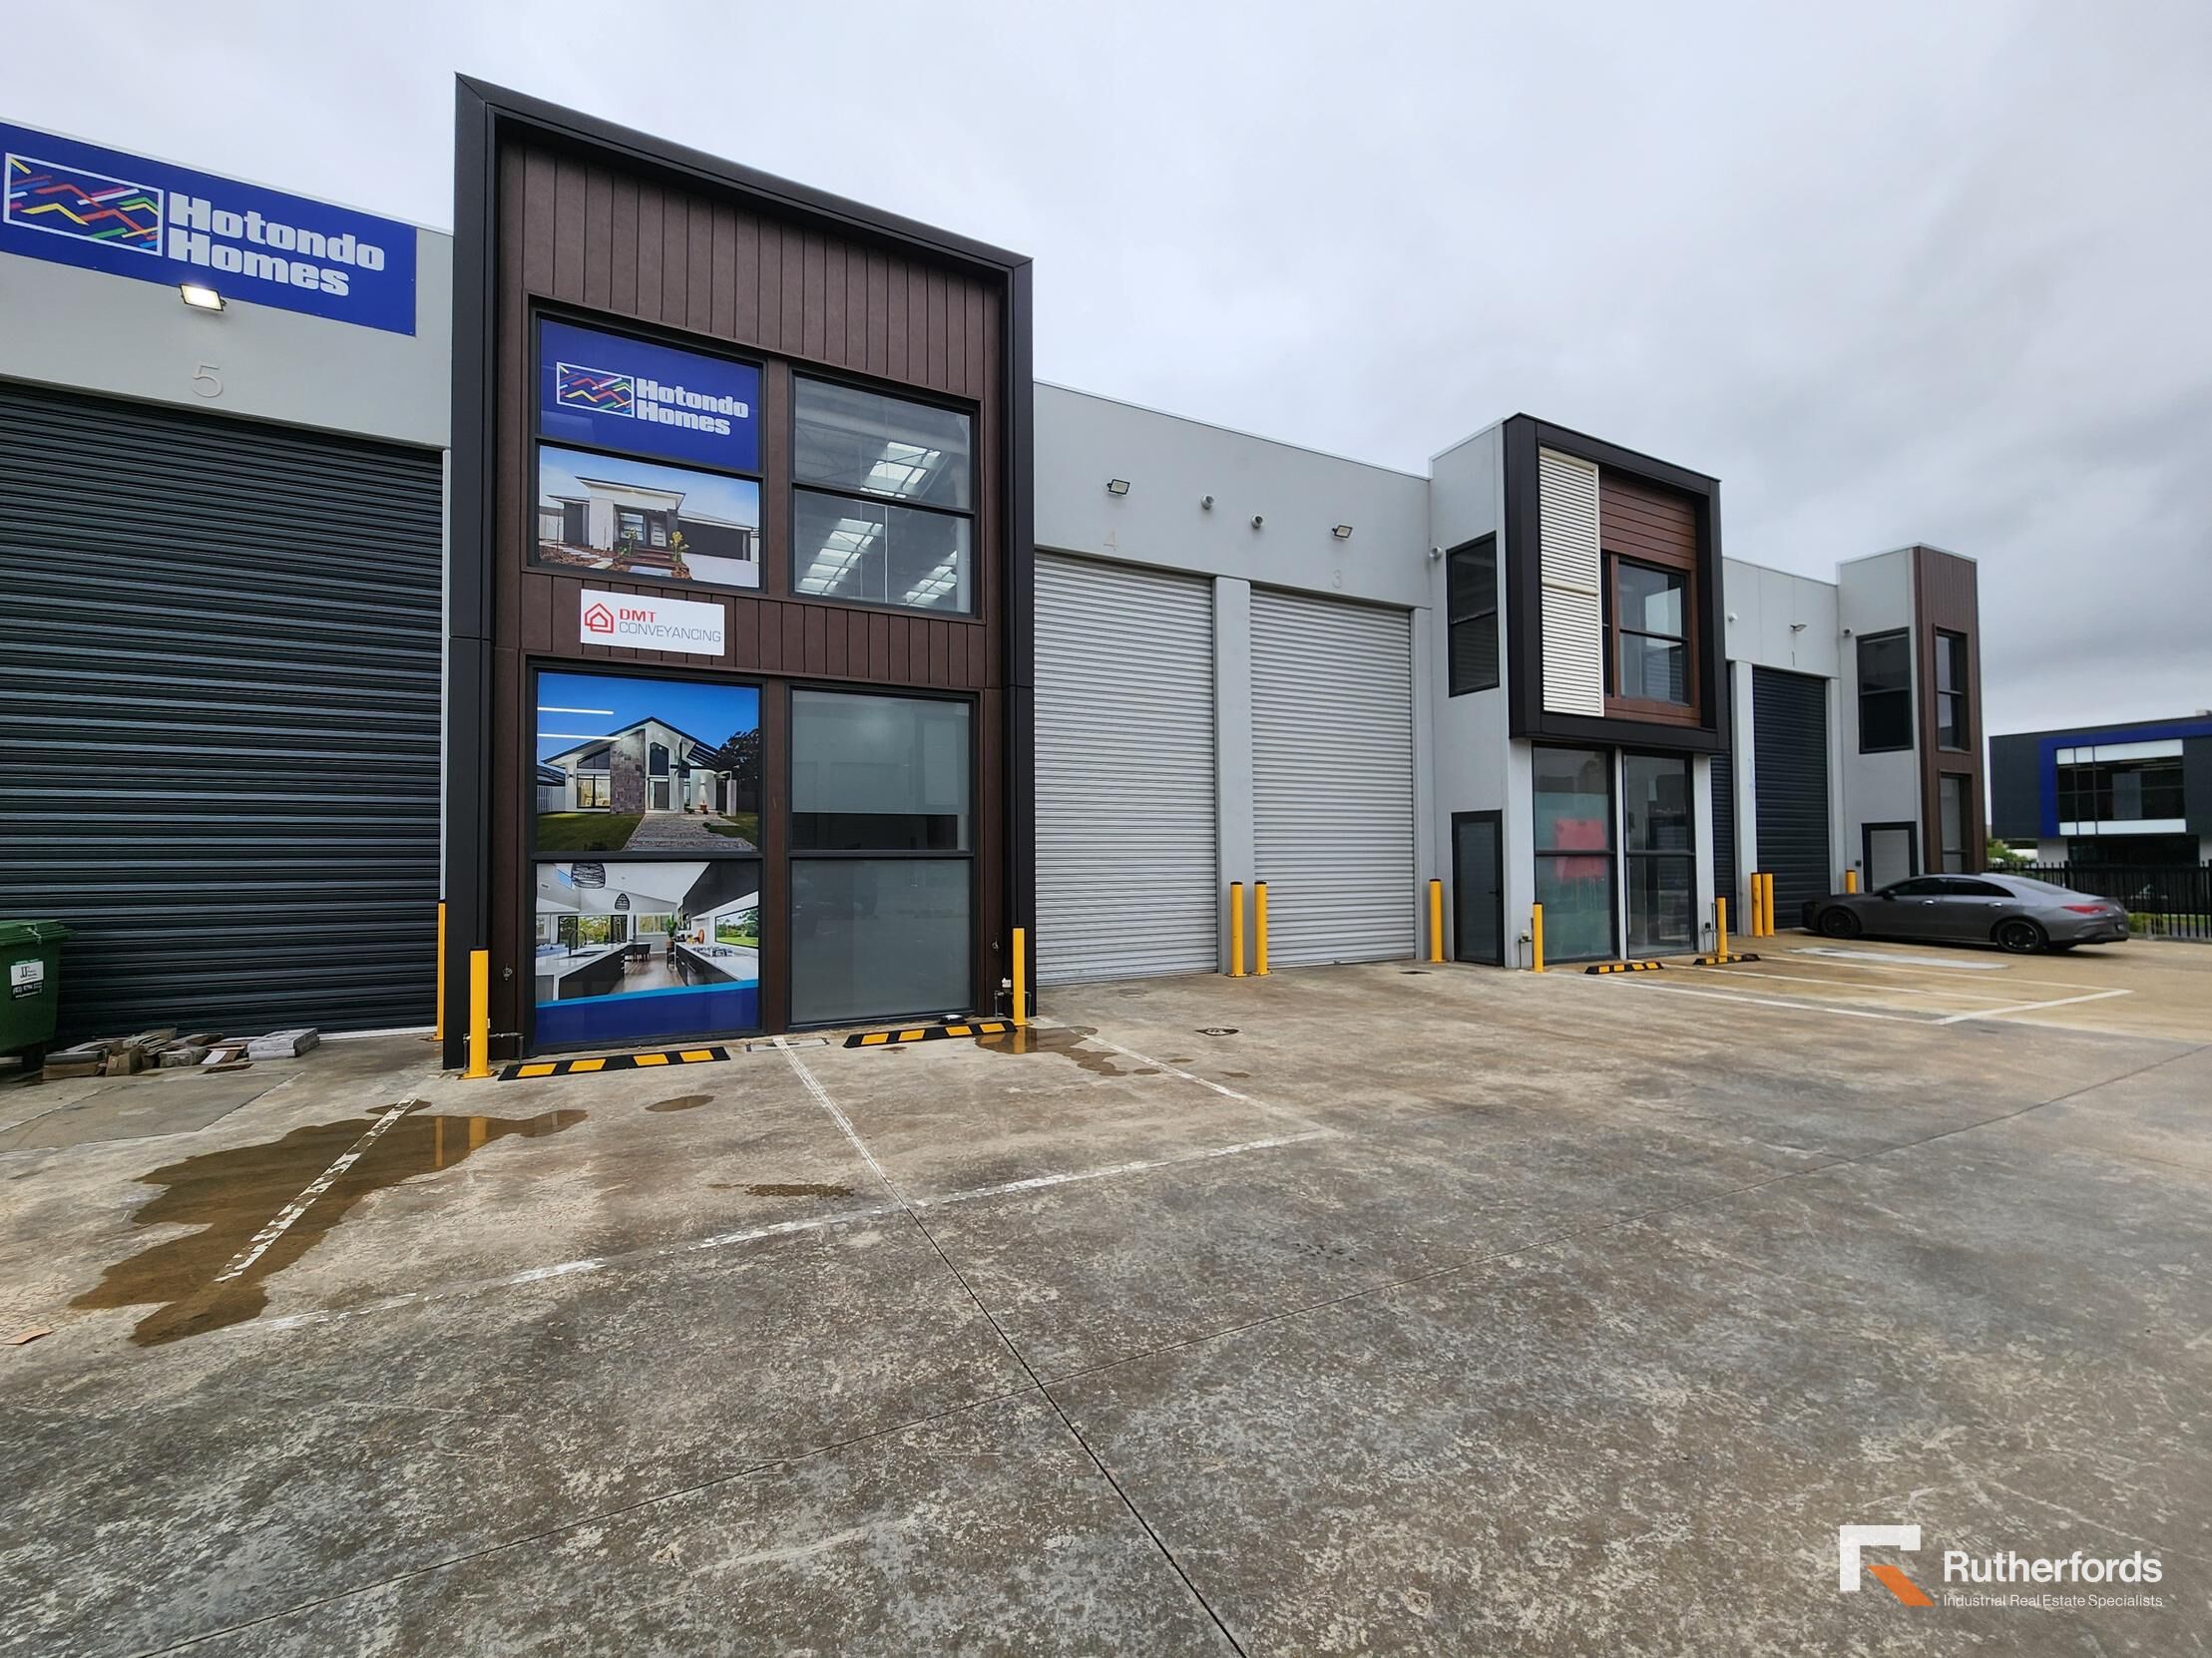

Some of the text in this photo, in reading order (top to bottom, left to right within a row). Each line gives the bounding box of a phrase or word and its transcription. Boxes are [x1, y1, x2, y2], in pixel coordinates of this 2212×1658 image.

[169, 192, 385, 271] Hotondo
[168, 227, 349, 296] Homes
[192, 363, 223, 398] 5
[637, 378, 749, 419] Hotondo
[637, 400, 730, 436] Homes
[1103, 530, 1118, 552] 4
[1332, 569, 1342, 590] 3
[619, 622, 721, 642] CONVEYANCING
[620, 609, 657, 622] DMT
